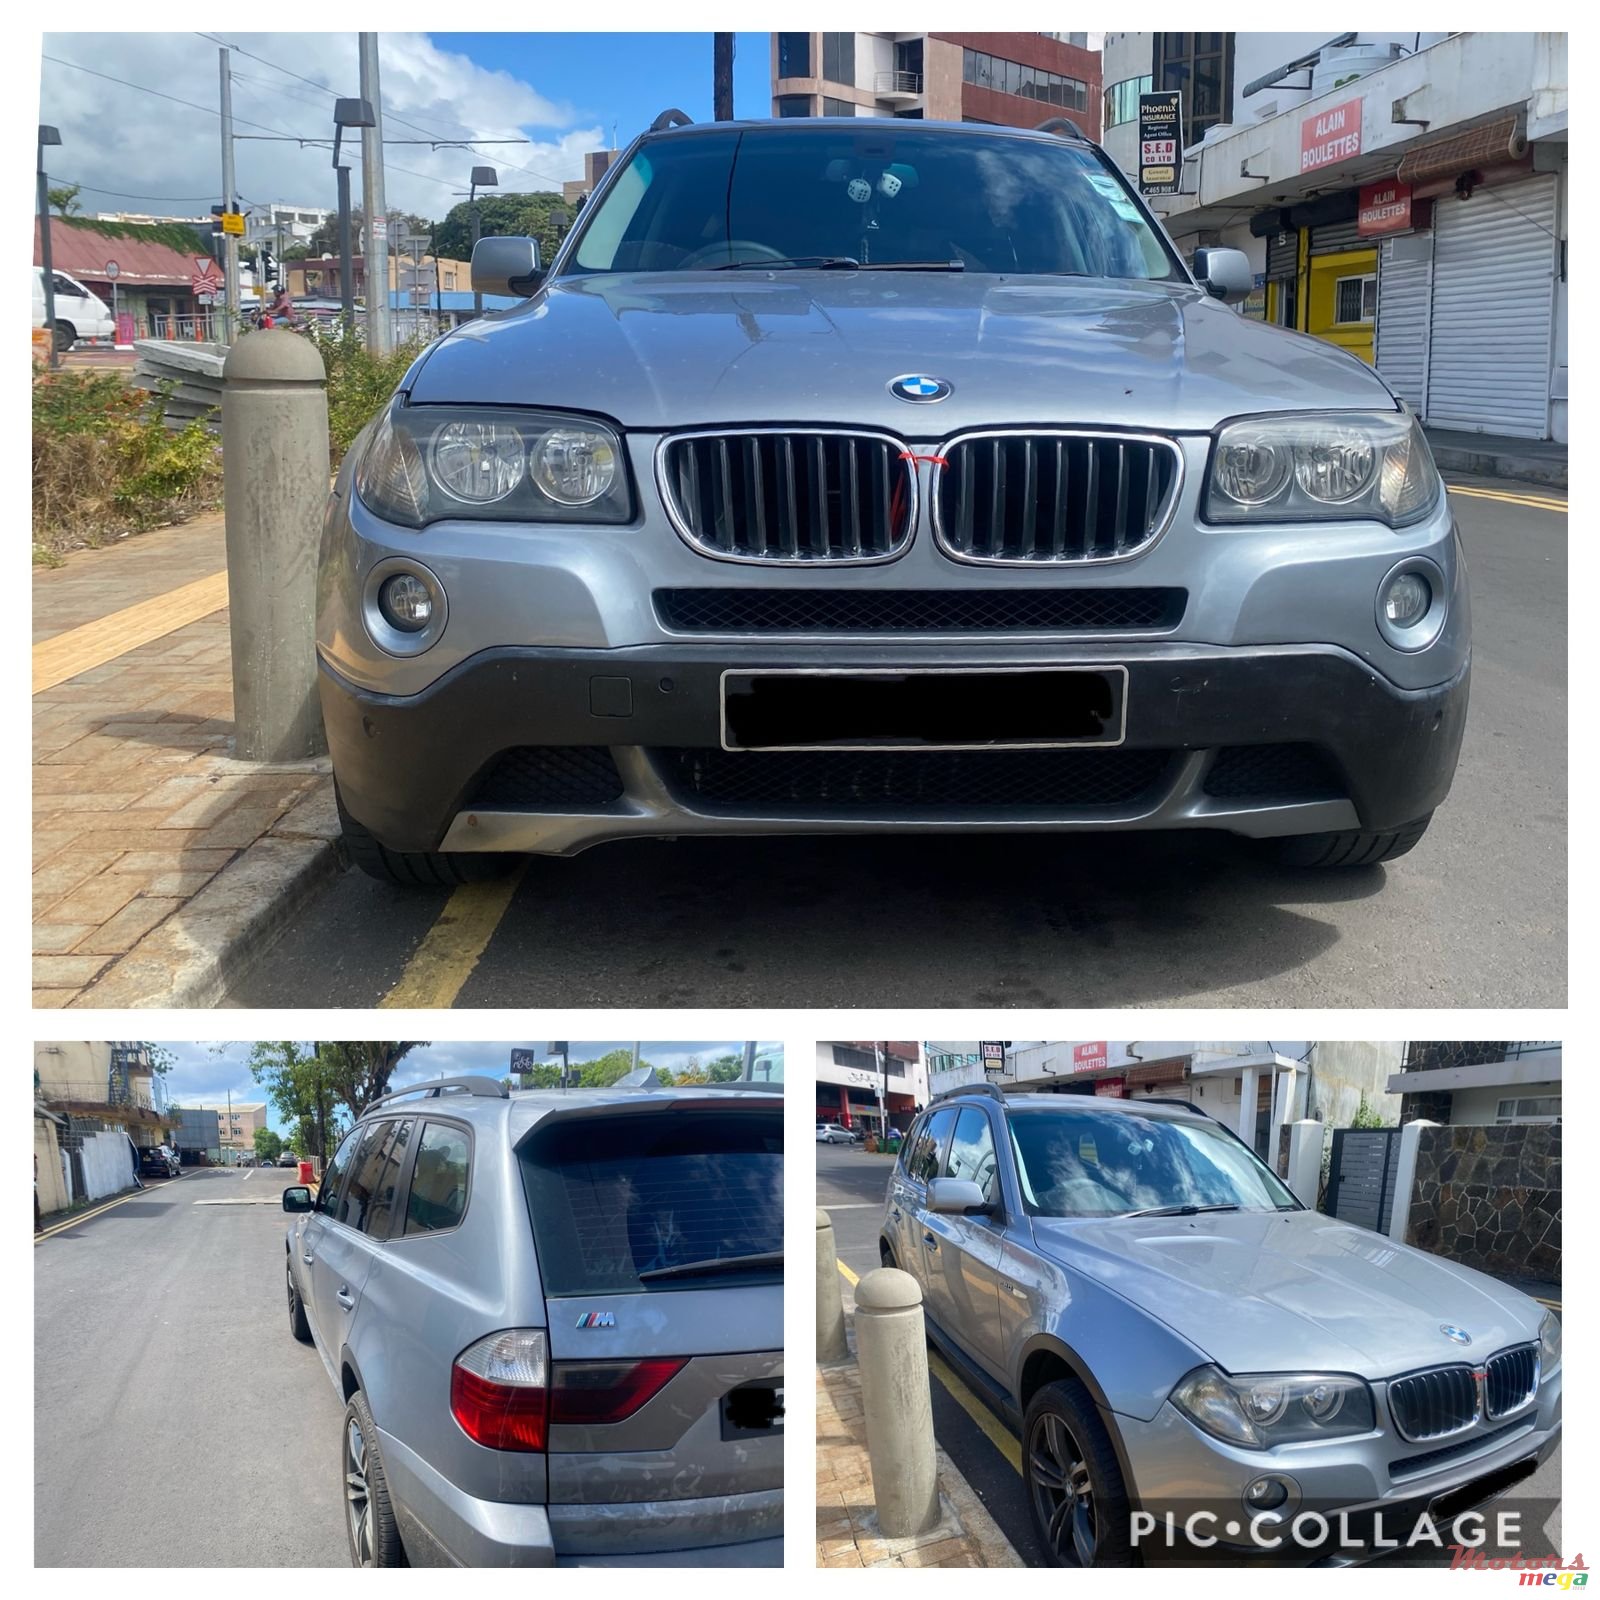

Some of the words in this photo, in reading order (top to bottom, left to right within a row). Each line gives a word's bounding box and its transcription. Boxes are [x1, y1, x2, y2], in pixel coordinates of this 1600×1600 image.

[1141, 104, 1176, 114] Phoenix
[1141, 113, 1176, 121] INSURANCE
[1315, 109, 1345, 138] ALAIN
[1302, 132, 1359, 169] BOULETTES
[1373, 190, 1395, 206] ALAIN
[1362, 203, 1405, 223] BOULETTES
[1081, 1044, 1098, 1056] ALAIN
[1074, 1057, 1106, 1071] BOULETTES
